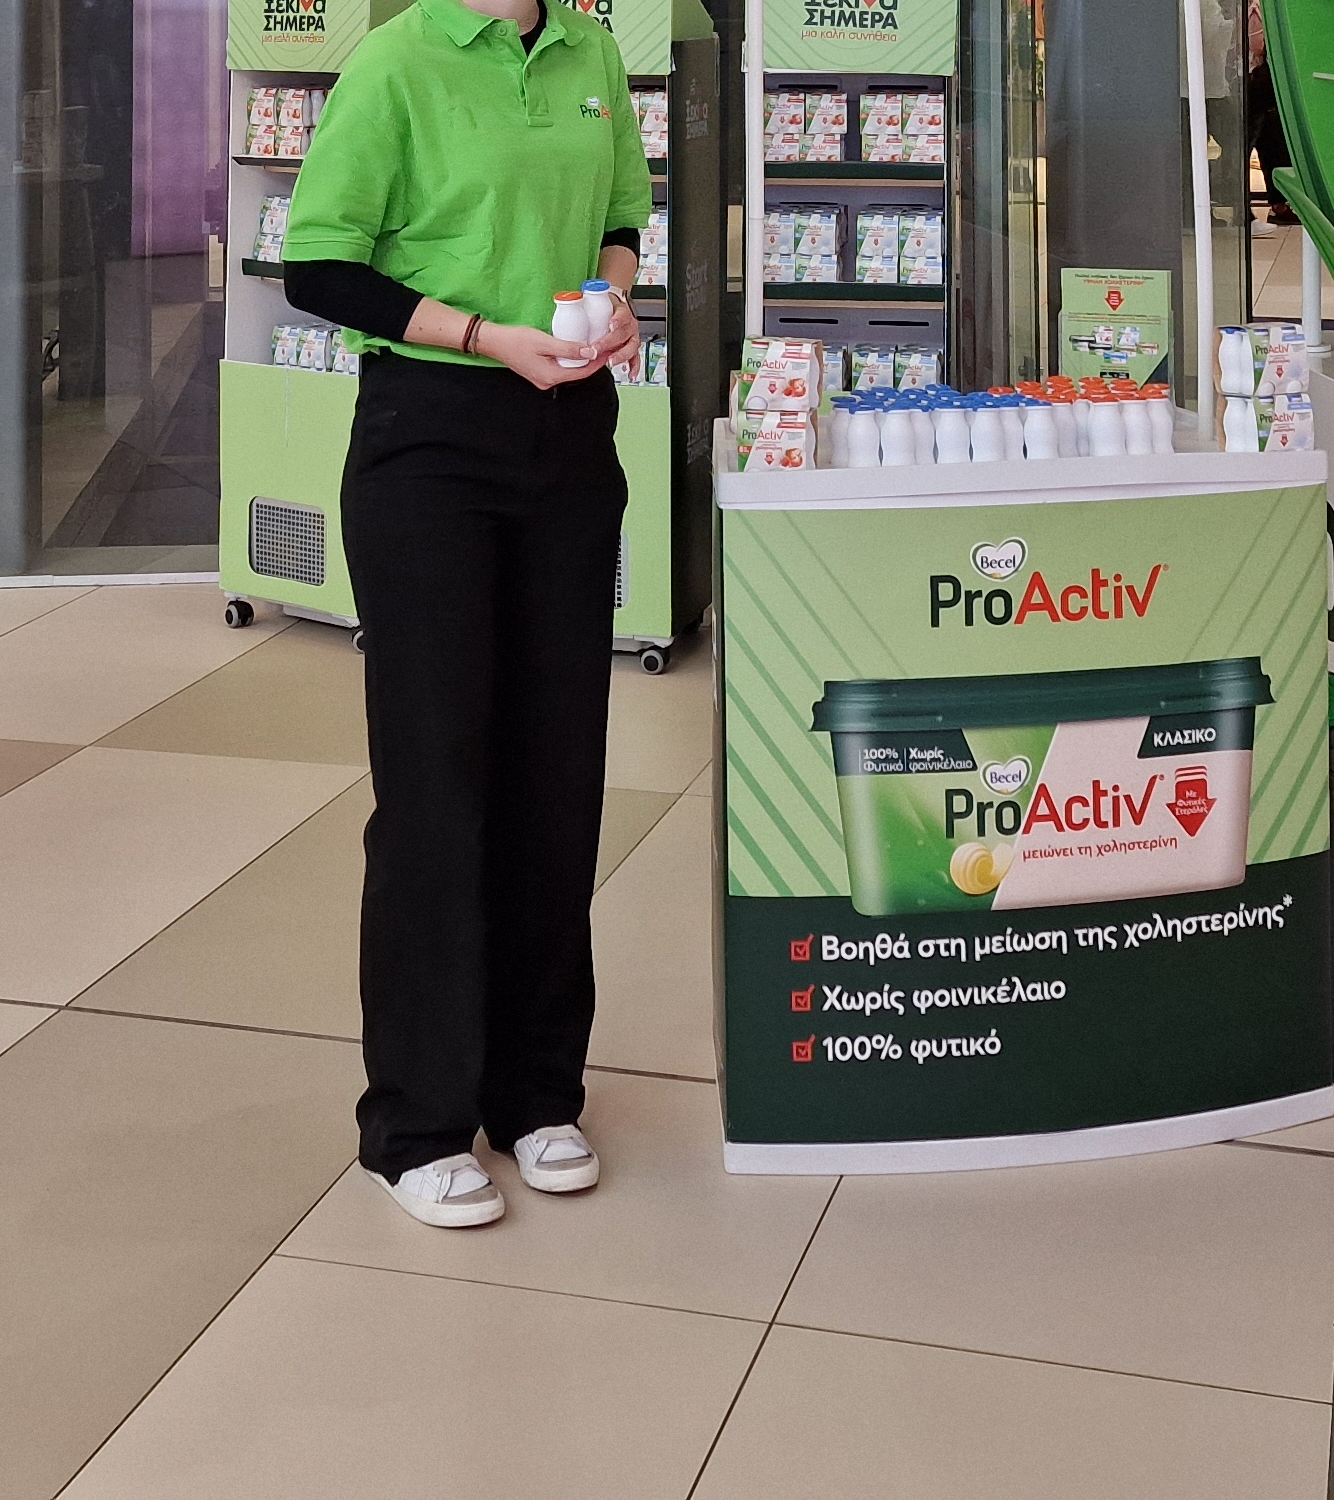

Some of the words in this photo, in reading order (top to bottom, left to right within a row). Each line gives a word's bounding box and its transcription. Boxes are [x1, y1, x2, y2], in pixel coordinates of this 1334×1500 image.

[263, 15, 326, 32] ΣΗΜΕΡΑ
[803, 8, 899, 30] ΣΗΜΕΡΑ
[980, 553, 1018, 570] Becel
[1153, 727, 1217, 748] ΚΛΑΣΙΚΟ
[863, 747, 899, 761] 100%
[909, 746, 944, 762] Χωρίς
[863, 758, 904, 773] Φυτικό
[909, 757, 973, 773] φοινικέλαιο
[989, 770, 1022, 785] Becel
[1022, 844, 1075, 862] μειώνει
[1077, 844, 1093, 858] τη
[1096, 836, 1179, 859] χοληστερίνη
[821, 931, 911, 966] Βοηθά
[918, 937, 967, 963] στη
[973, 924, 1068, 961] μείωση
[1074, 922, 1118, 951] της
[822, 983, 905, 1016] Χωρίς
[912, 976, 1067, 1014] φοινικέλαιο
[822, 1034, 903, 1063] 100%
[910, 1028, 1002, 1064] φυτικό
